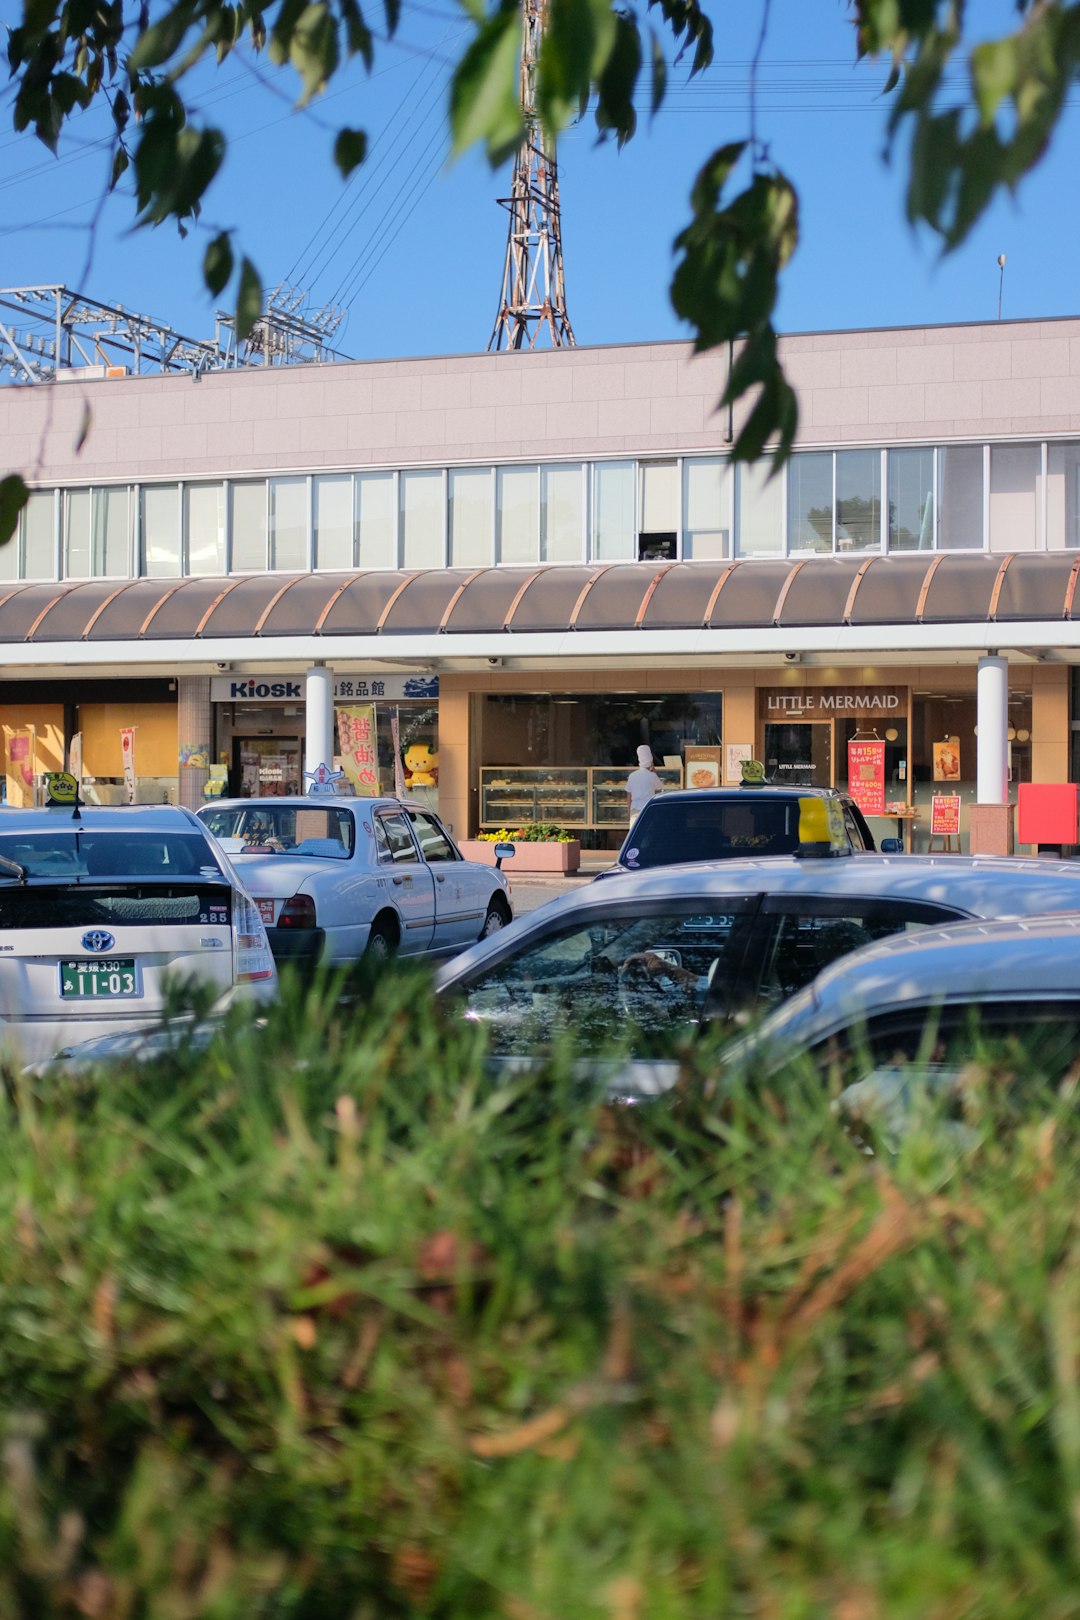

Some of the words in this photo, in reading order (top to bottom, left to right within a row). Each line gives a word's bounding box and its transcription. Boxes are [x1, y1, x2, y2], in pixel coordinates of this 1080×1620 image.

[230, 680, 301, 698] Kiosk
[333, 681, 385, 696] 銘品館
[767, 696, 815, 710] LITTLE
[819, 695, 899, 709] MERMAID
[199, 912, 227, 923] 285
[63, 979, 74, 991] あ
[78, 973, 134, 995] 11-03
